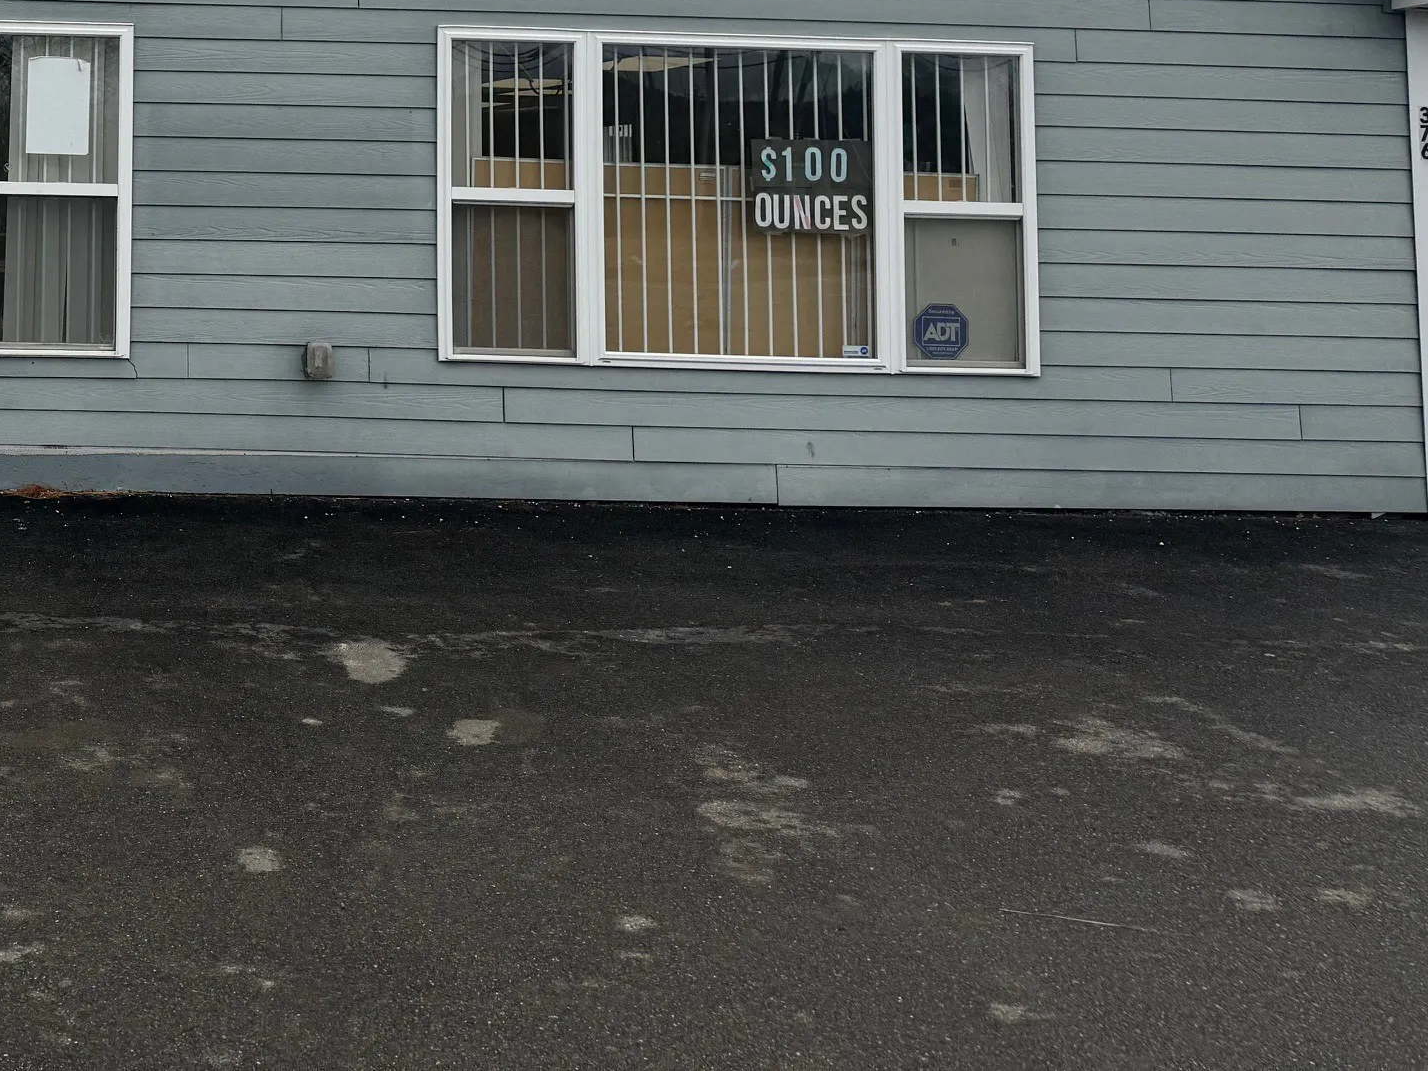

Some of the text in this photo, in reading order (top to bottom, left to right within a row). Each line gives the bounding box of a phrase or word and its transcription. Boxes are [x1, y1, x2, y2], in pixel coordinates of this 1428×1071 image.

[760, 146, 848, 183] $100
[754, 192, 868, 231] OUNCES
[923, 322, 961, 342] ADT
